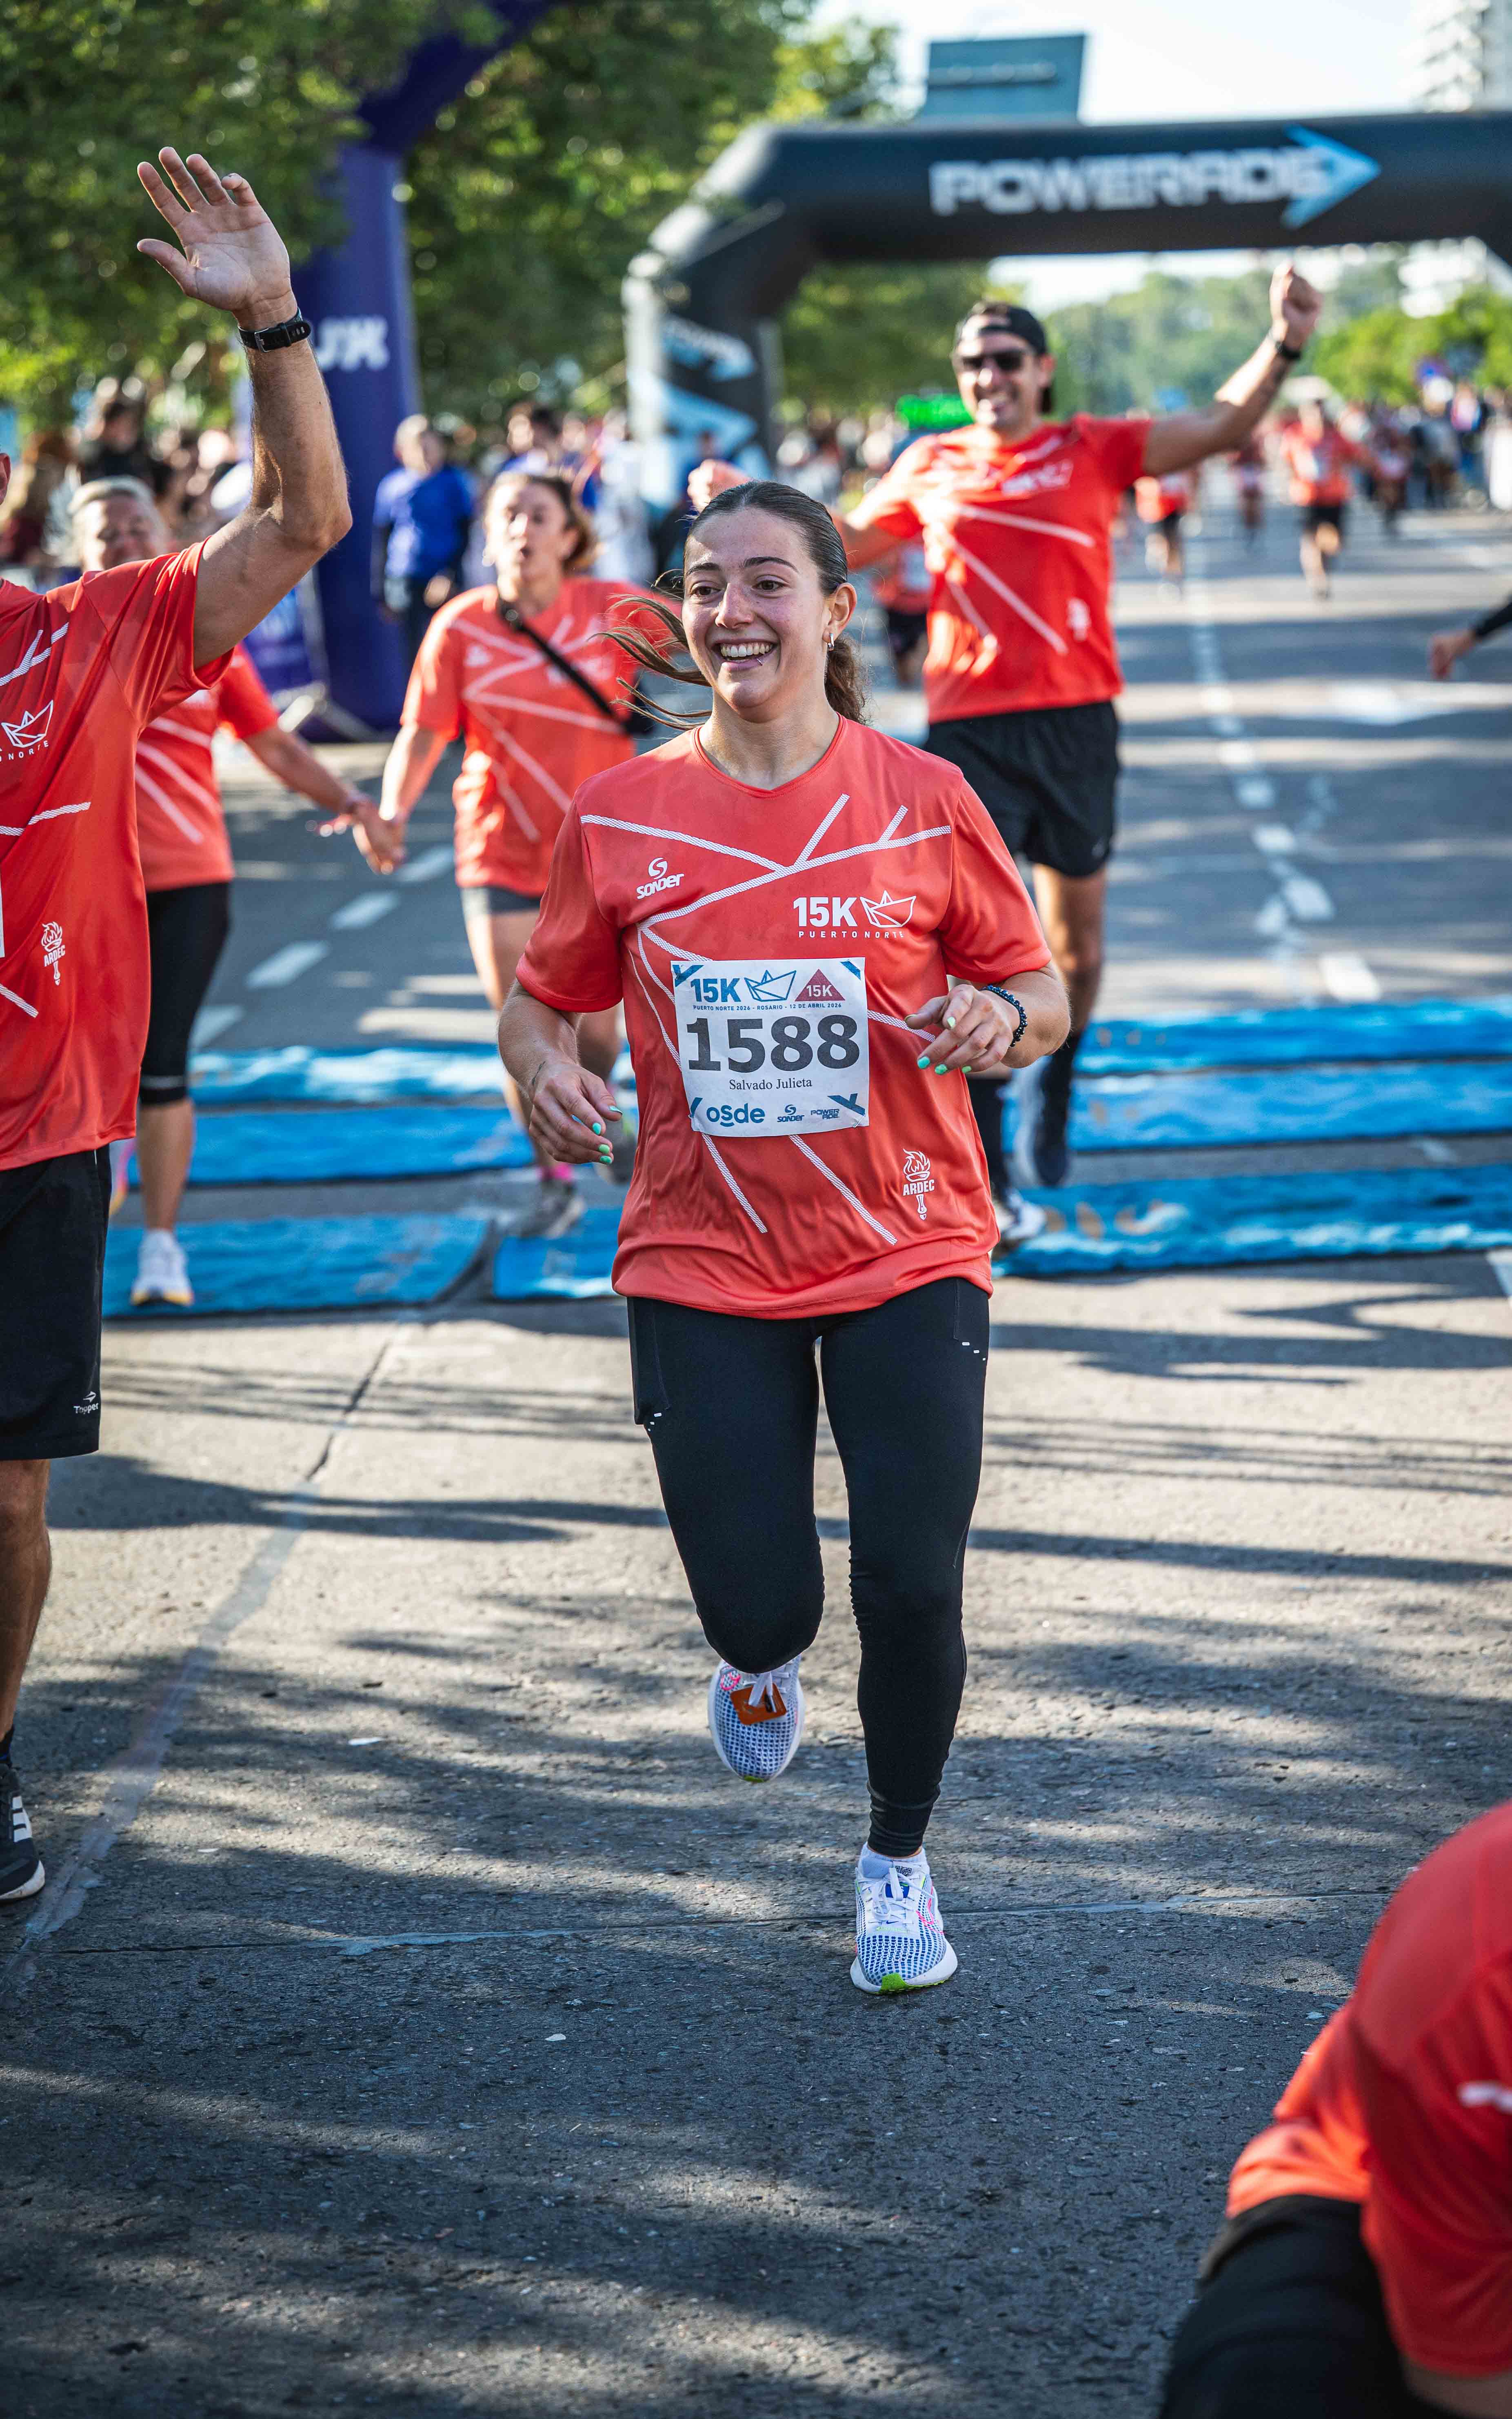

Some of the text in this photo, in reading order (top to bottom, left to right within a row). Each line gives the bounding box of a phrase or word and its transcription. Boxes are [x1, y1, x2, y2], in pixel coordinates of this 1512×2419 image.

[929, 148, 1334, 216] POWERADE
[793, 897, 857, 926] 15K
[44, 944, 65, 967] ARDEC
[691, 977, 741, 1002] 15K
[806, 984, 833, 997] 15K
[686, 1015, 860, 1073] 1588
[729, 1078, 813, 1090] Salvado Julieta
[706, 1103, 765, 1125] osde
[903, 1179, 935, 1196] ARDEC
